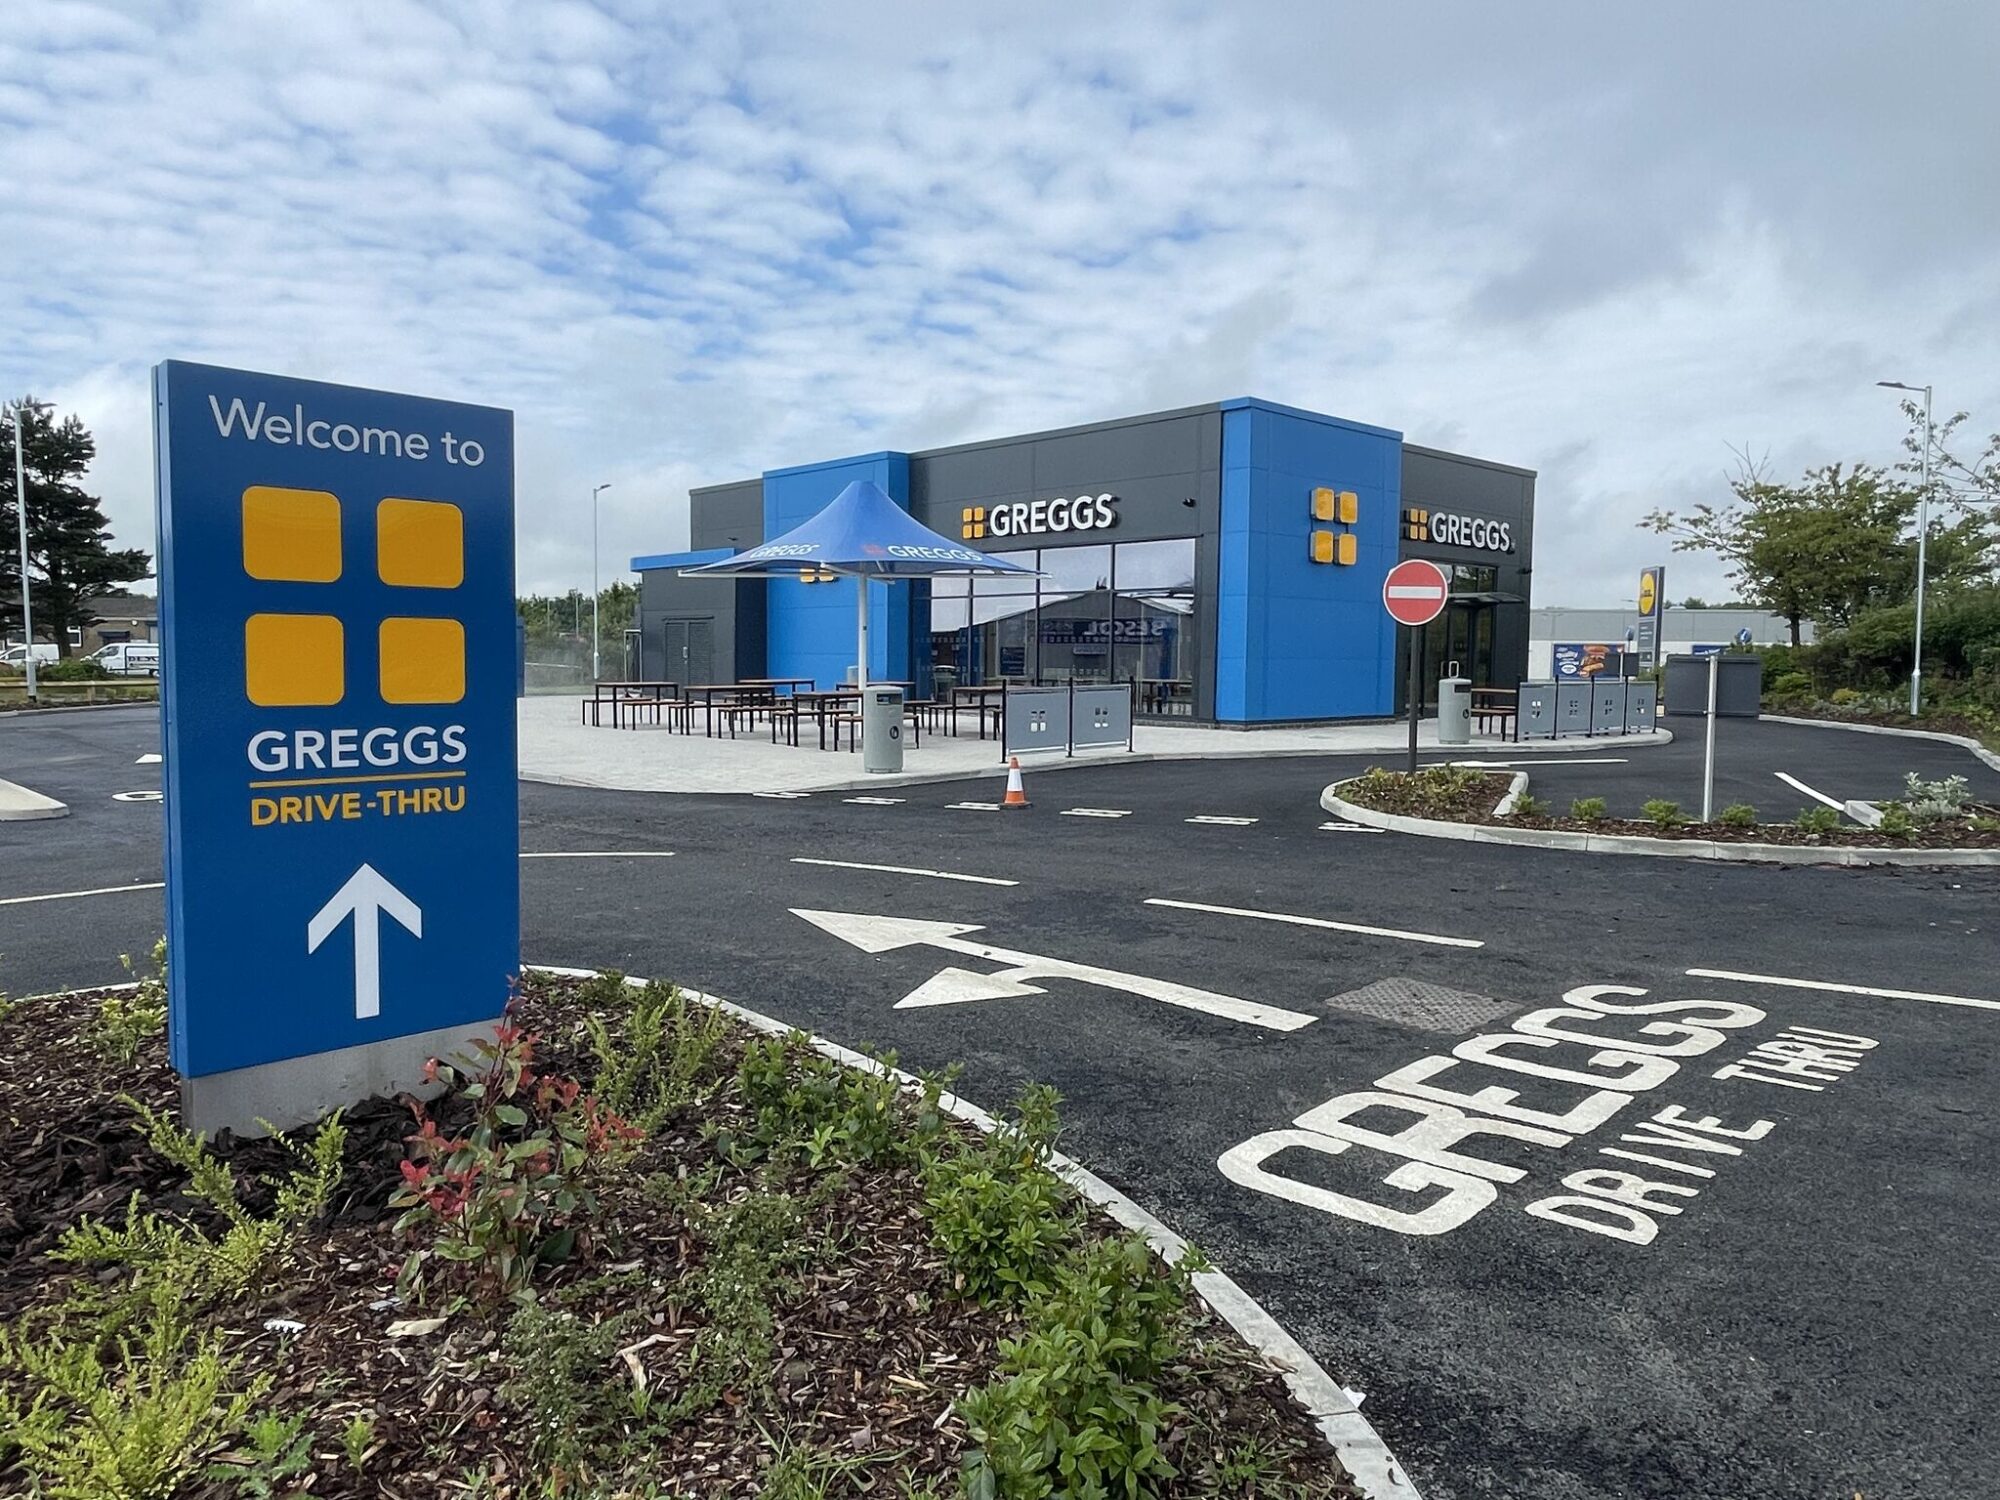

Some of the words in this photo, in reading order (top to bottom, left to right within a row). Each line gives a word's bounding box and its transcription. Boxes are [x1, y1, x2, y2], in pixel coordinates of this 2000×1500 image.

[208, 395, 429, 460] Welcome
[441, 431, 485, 466] to
[990, 493, 1113, 537] GREGGS
[1432, 512, 1510, 552] GREGGS
[750, 544, 820, 559] GREGGS
[887, 545, 983, 561] GREGGS
[247, 725, 467, 772] GREGGS
[251, 786, 466, 826] DRIVE-THRU
[1217, 984, 1767, 1235] GREGGS
[1524, 1104, 1777, 1245] DRIVE
[1713, 1025, 1880, 1092] THRU
